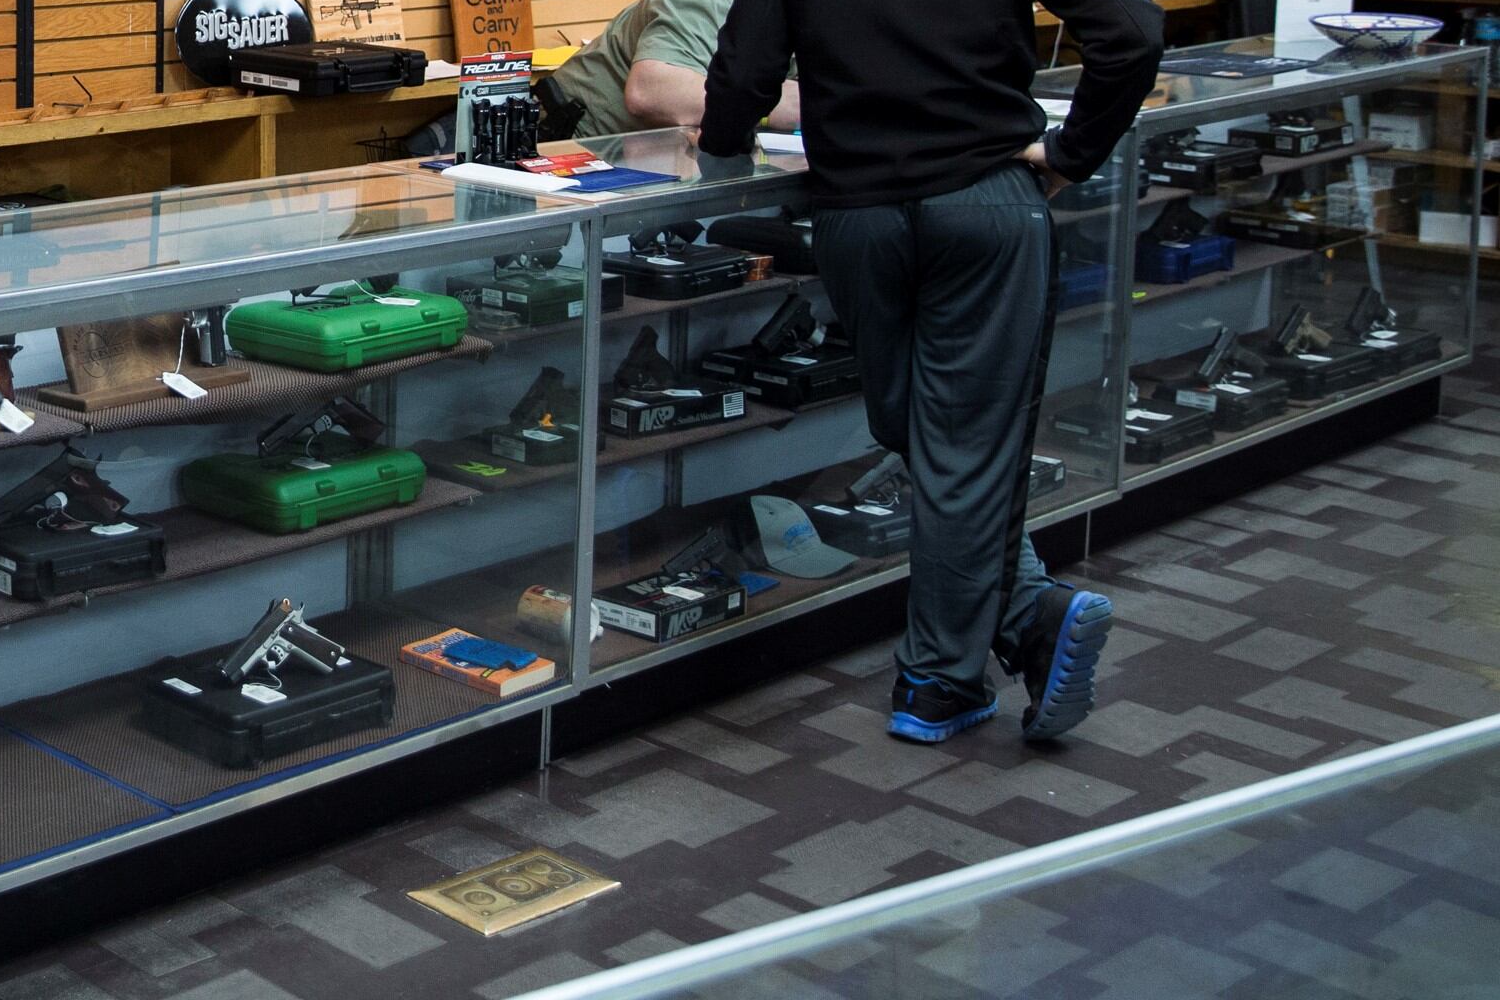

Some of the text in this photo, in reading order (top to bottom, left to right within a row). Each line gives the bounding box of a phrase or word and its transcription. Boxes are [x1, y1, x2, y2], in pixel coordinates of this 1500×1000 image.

[487, 3, 504, 15] and
[195, 10, 228, 43] SIG
[227, 15, 289, 50] SAUER
[473, 15, 520, 36] Carry
[487, 37, 512, 52] On
[464, 60, 527, 75] REDLINE
[639, 405, 675, 432] M&P
[666, 606, 703, 640] M&P
